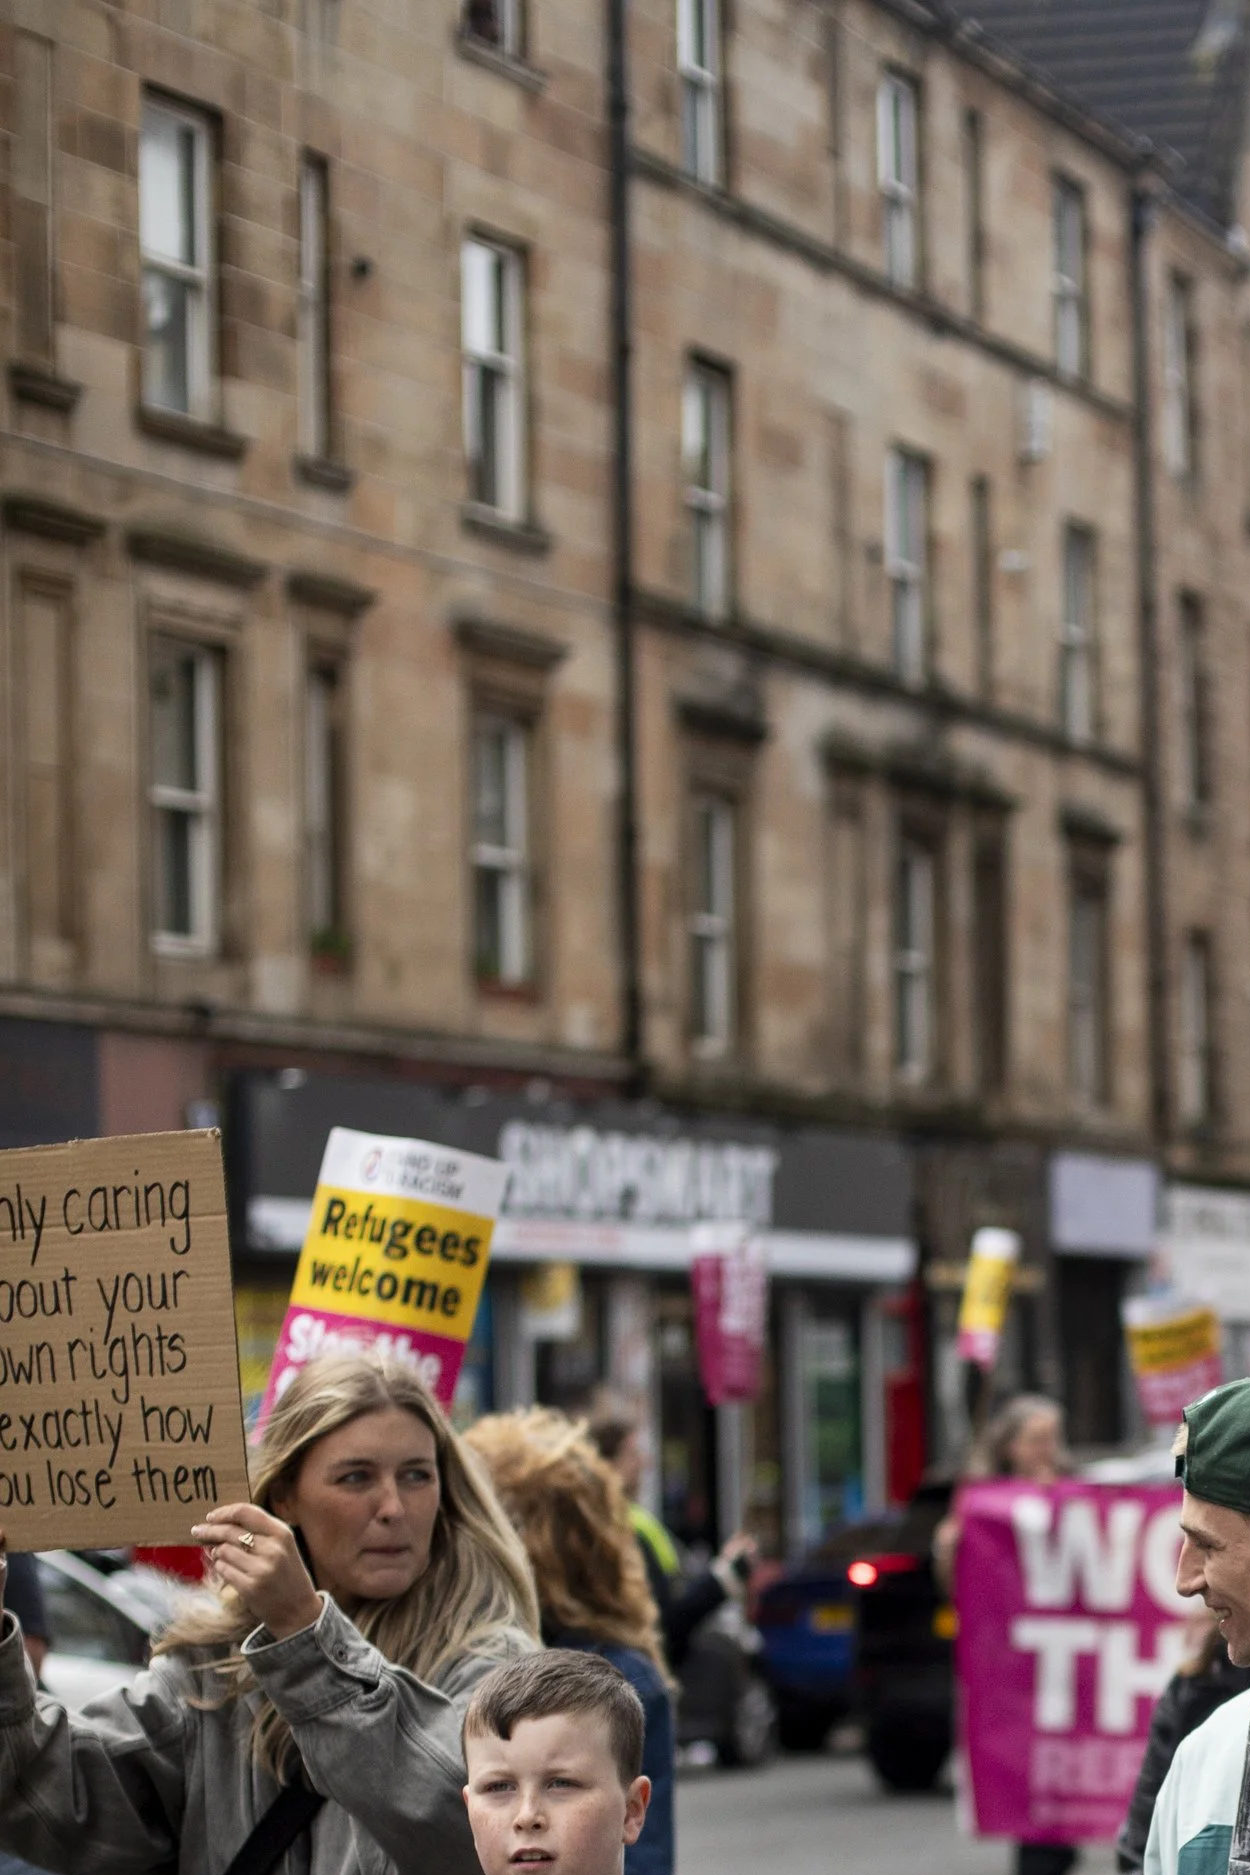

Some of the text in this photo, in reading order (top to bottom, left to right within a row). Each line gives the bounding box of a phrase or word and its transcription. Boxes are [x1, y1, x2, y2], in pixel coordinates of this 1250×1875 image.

[0, 1169, 191, 1266] nly caring
[320, 1197, 482, 1268] Refugees
[96, 1269, 190, 1346] your
[310, 1255, 463, 1317] welcome
[67, 1323, 187, 1405] rights
[0, 1395, 214, 1469] exactly how
[0, 1456, 218, 1509] ou lose them
